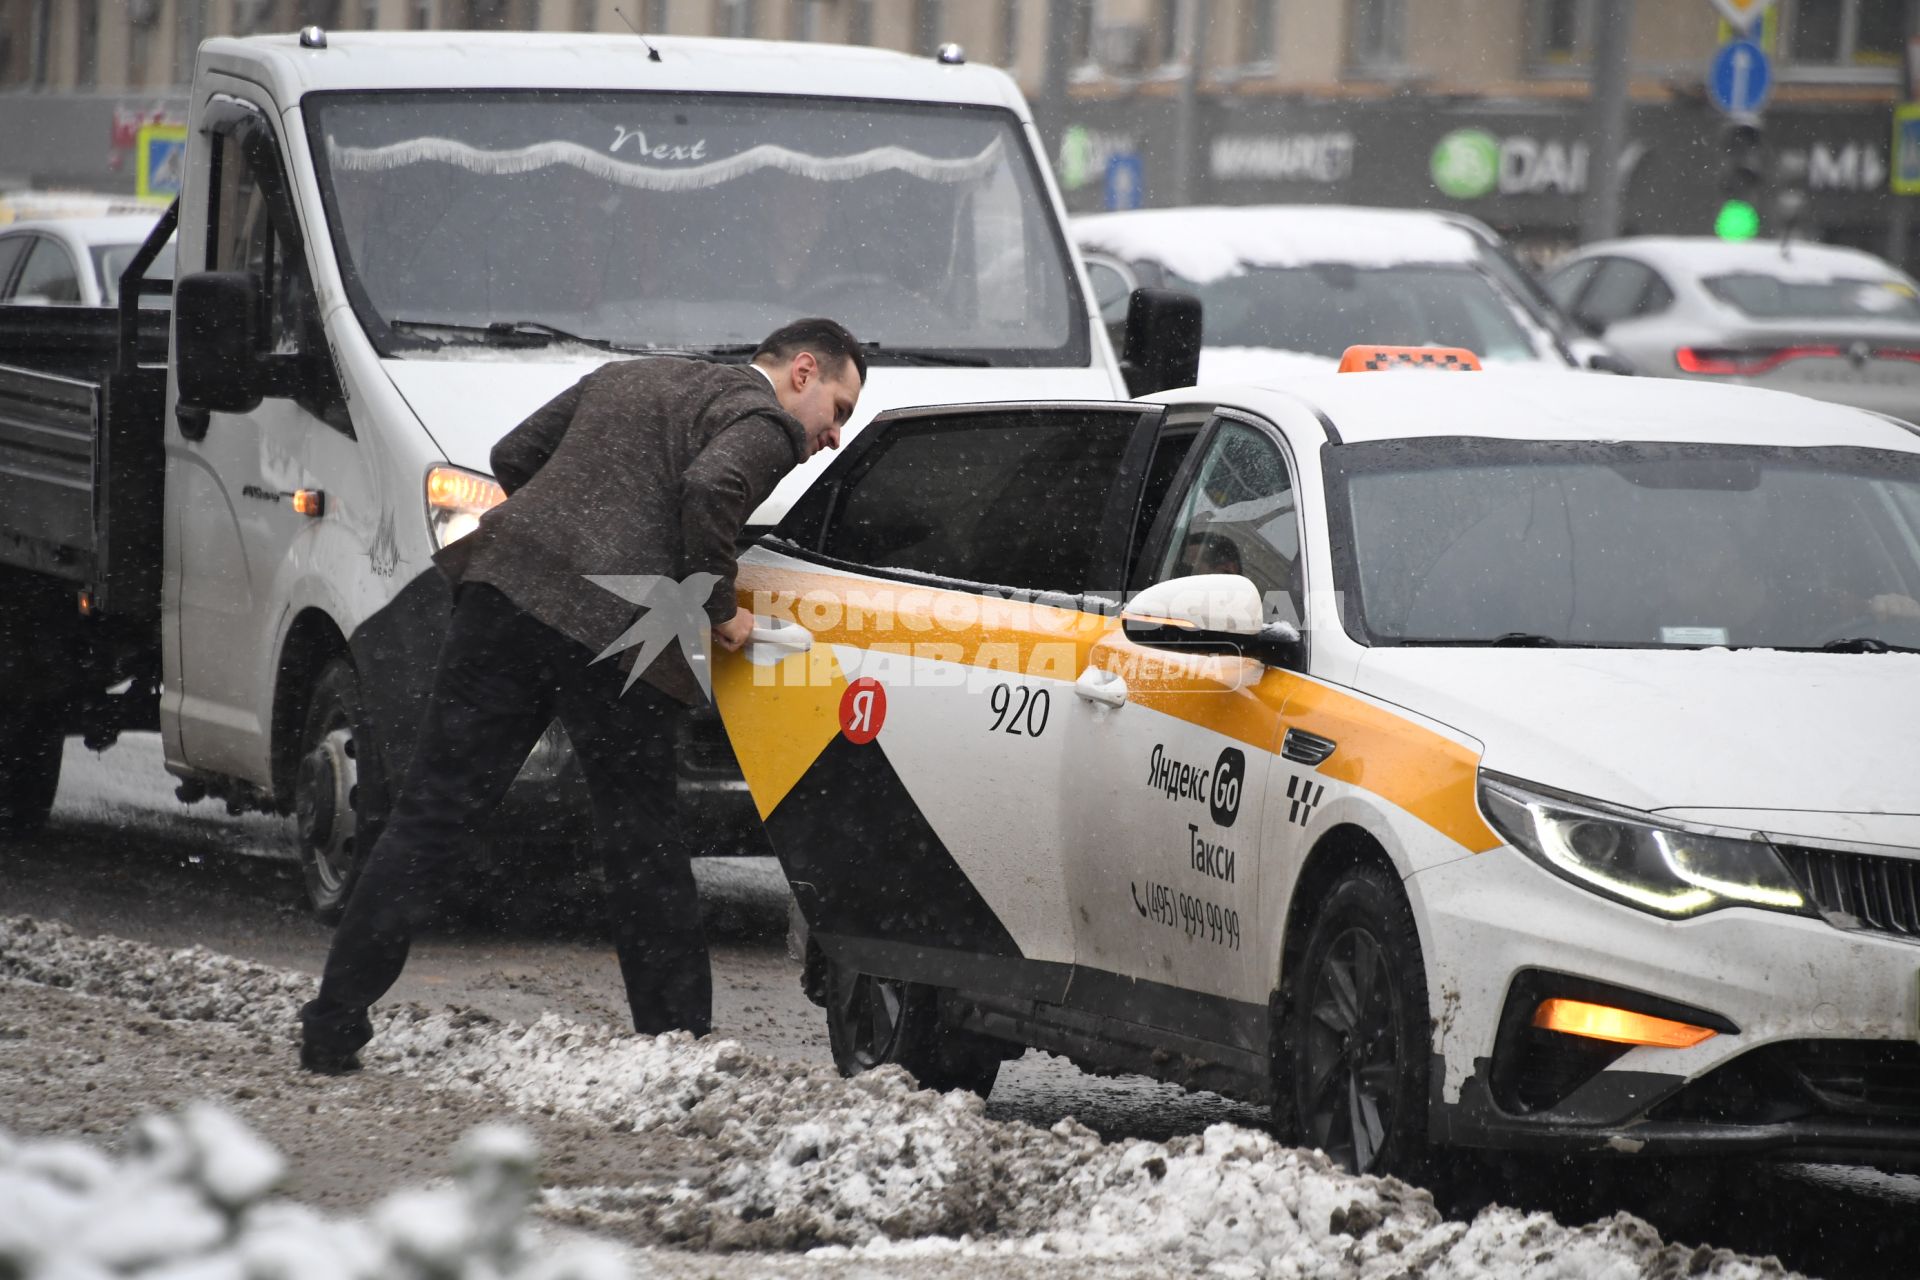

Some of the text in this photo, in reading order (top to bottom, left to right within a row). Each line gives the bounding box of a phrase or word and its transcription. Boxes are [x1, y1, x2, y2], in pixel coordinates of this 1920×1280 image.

[849, 690, 875, 732] Я
[989, 682, 1051, 738] 920
[1147, 743, 1239, 812] Яндекс Go
[1188, 823, 1235, 884] Такси
[1145, 880, 1240, 952] (495) 999 99 99
